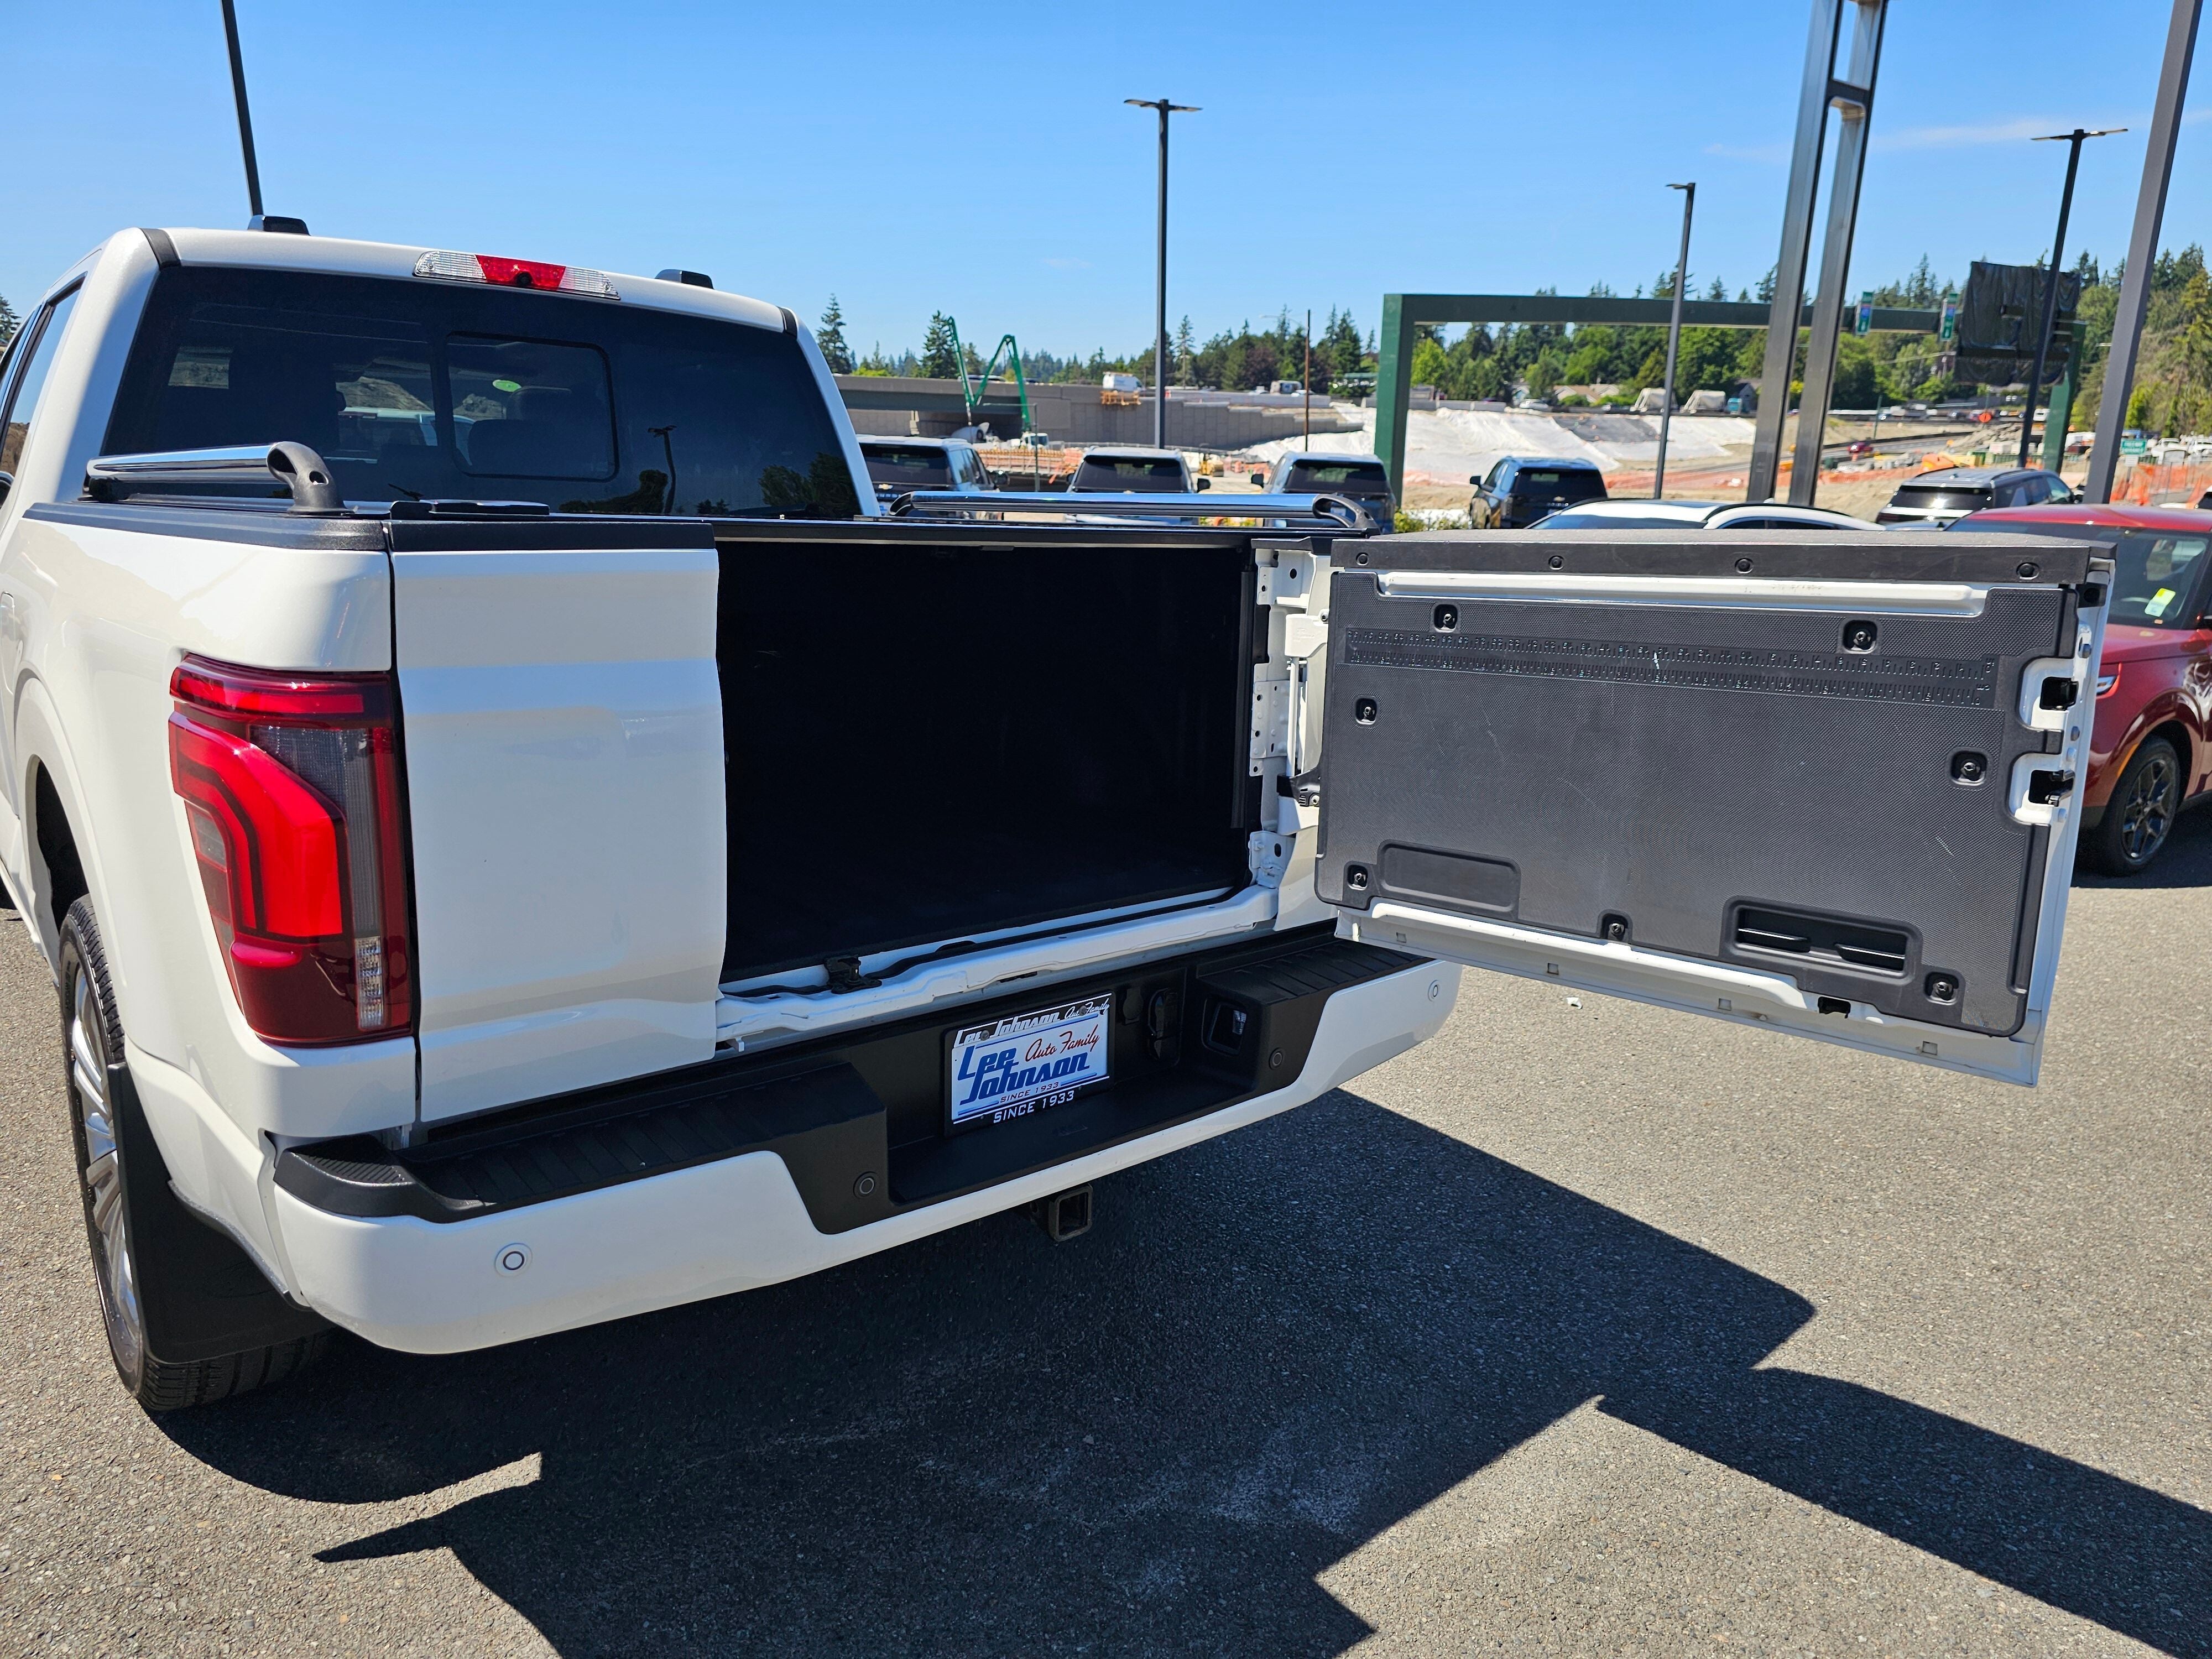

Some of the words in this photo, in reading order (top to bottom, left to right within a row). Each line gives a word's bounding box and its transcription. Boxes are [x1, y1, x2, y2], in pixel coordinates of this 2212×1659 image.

[991, 1012, 1060, 1037] Johnson
[1025, 1039, 1057, 1062] Auto
[1060, 1024, 1100, 1053] Family
[958, 1045, 1017, 1081] Lee
[959, 1052, 1090, 1105] Johnson
[993, 1101, 1035, 1123] SINCE
[1042, 1090, 1075, 1108] 1933
[1000, 1090, 1030, 1103] SINCE
[1035, 1082, 1059, 1093] 1933
